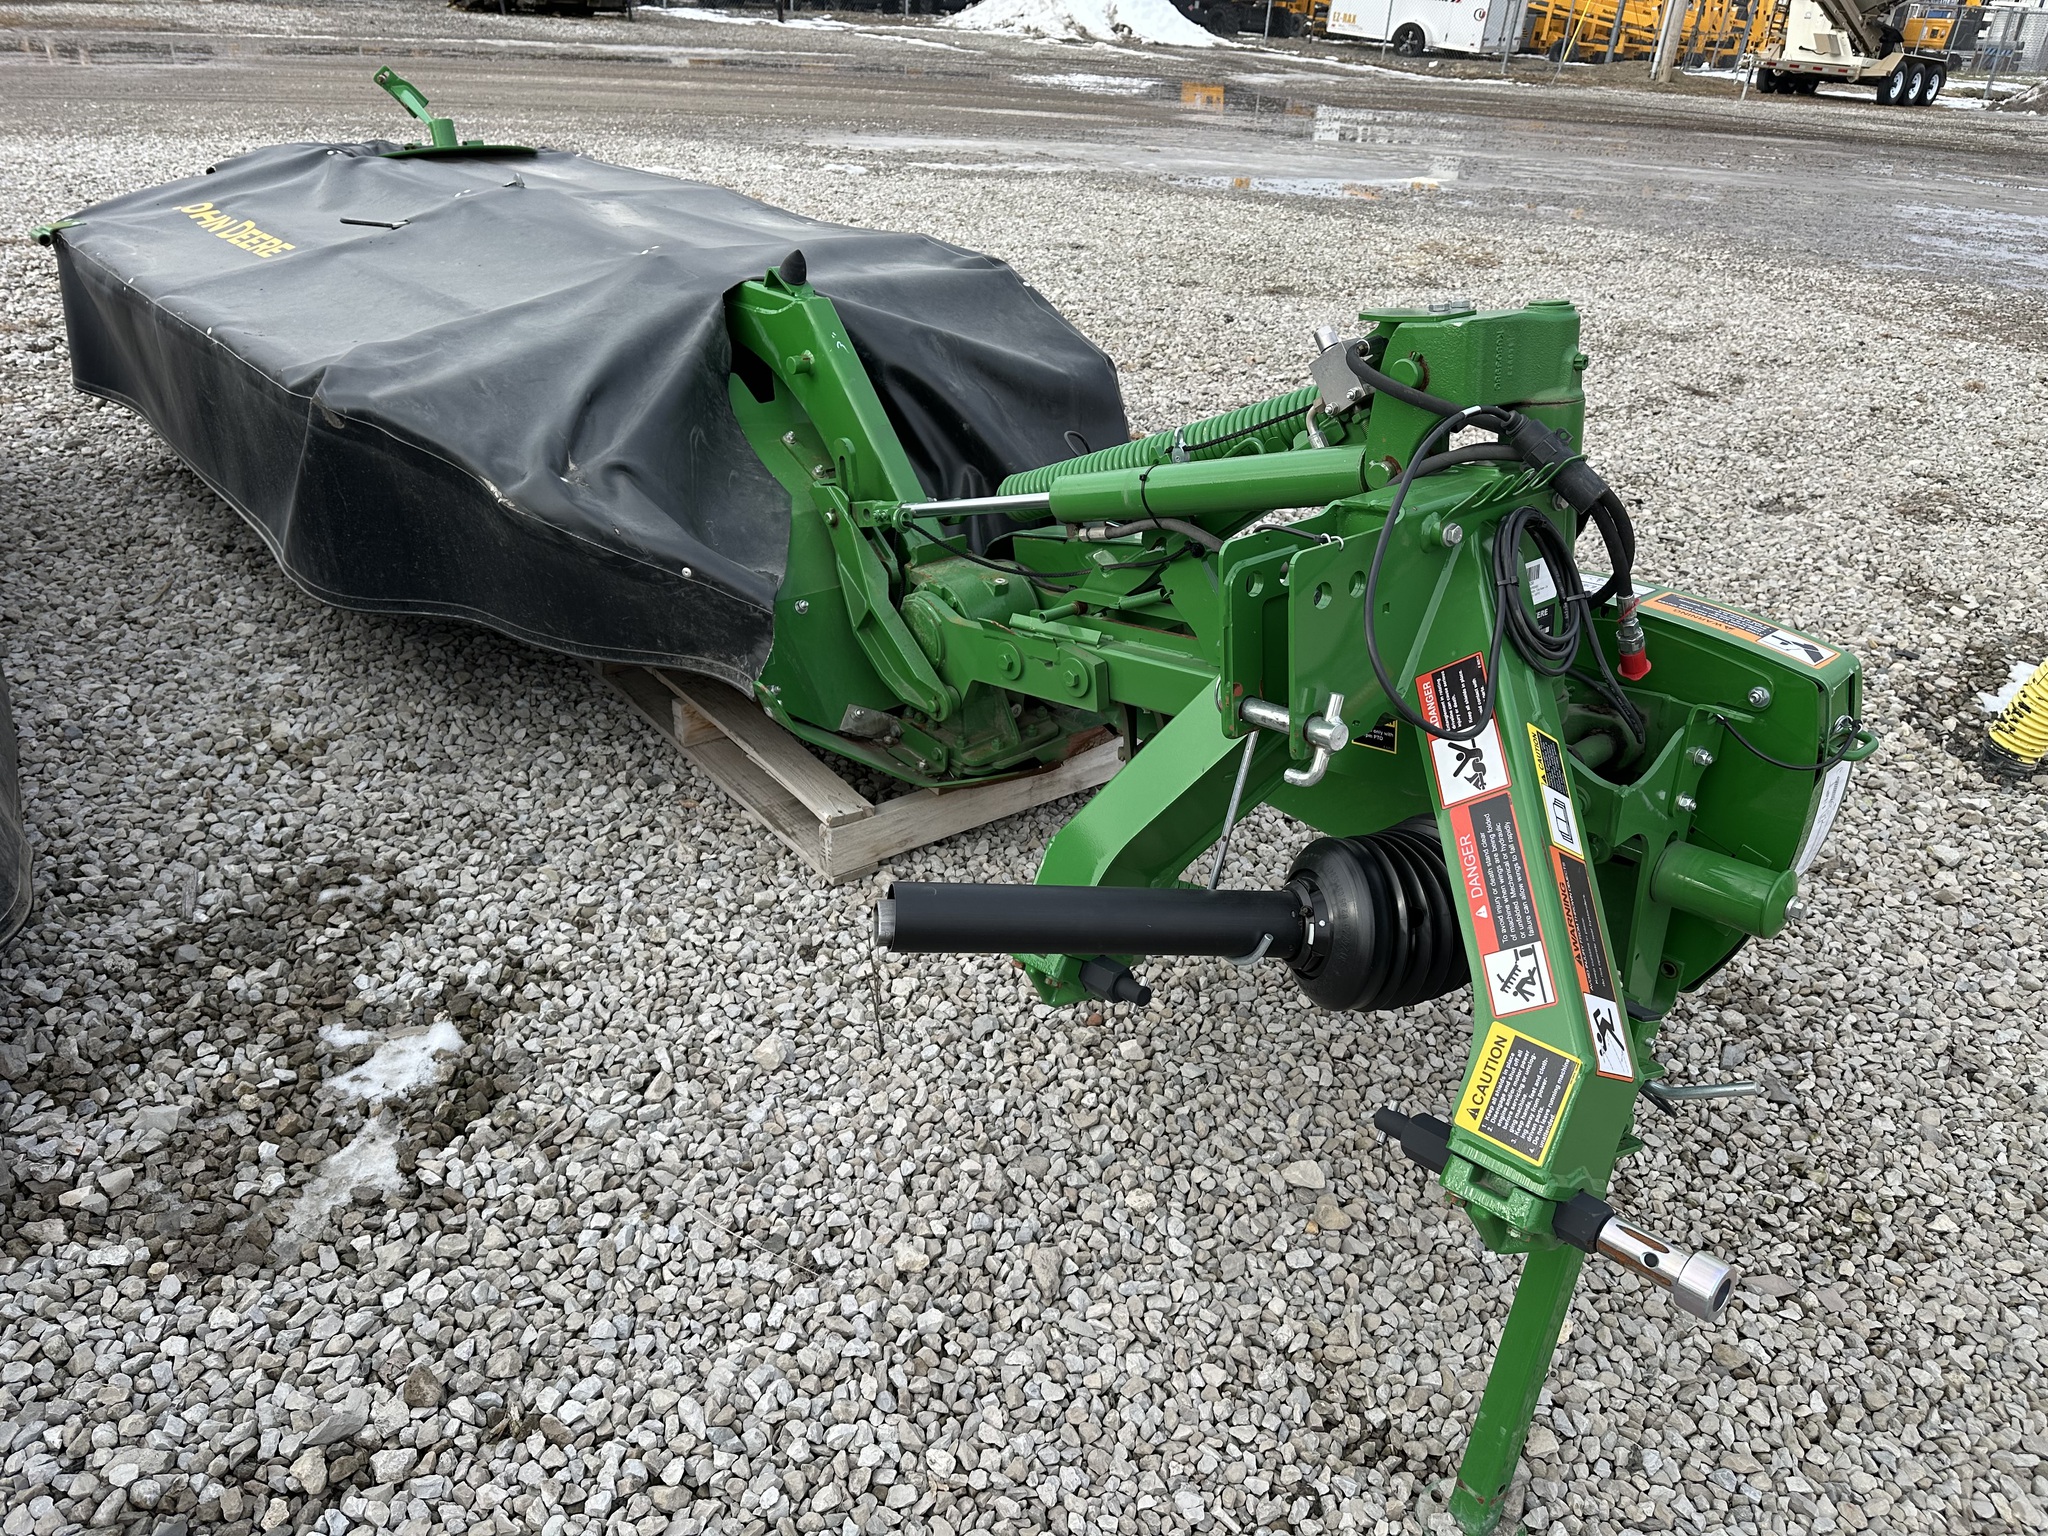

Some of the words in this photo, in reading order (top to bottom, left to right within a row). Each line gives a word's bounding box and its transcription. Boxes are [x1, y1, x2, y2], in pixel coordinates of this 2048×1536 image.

[172, 202, 238, 232] OHN
[215, 220, 296, 258] DEERE
[1422, 681, 1438, 724] DANGER
[1531, 731, 1544, 771] CAUTION
[1483, 813, 1493, 833] folded
[1479, 831, 1487, 848] clear
[1488, 833, 1498, 852] being
[1494, 822, 1507, 852] hydraulic
[1458, 833, 1483, 898] DANGER
[1482, 848, 1491, 866] stand
[1486, 867, 1496, 886] death
[1496, 864, 1505, 884] wings
[1503, 860, 1516, 898] Mechanical
[1513, 861, 1523, 882] wings
[1500, 884, 1508, 903] when
[1517, 882, 1526, 900] allow
[1493, 895, 1503, 914] injury
[1497, 915, 1506, 933] avoid
[1504, 904, 1515, 932] machine
[1524, 914, 1534, 936] failure
[1558, 880, 1580, 952] WARNING
[1501, 934, 1508, 943] To
[1520, 930, 1525, 938] or
[1470, 1034, 1507, 1106] CAUTION
[1484, 1104, 1494, 1121] Keep
[1494, 1075, 1506, 1096] shields
[1490, 1092, 1507, 1124] Disengage
[1502, 1080, 1510, 1092] and
[1507, 1066, 1516, 1080] shut
[1496, 1106, 1508, 1127] engine
[1504, 1086, 1515, 1106] and/or
[1512, 1068, 1522, 1086] motor
[1519, 1049, 1530, 1069] power
[1502, 1110, 1513, 1130] before
[1510, 1082, 1525, 1110] servicing
[1508, 1118, 1518, 1133] ging
[1514, 1091, 1528, 1119] machine.
[1514, 1119, 1525, 1136] Keep
[1528, 1086, 1537, 1099] feet
[1533, 1074, 1541, 1087] and
[1531, 1097, 1540, 1112] from
[1532, 1135, 1539, 1145] Do
[1540, 1108, 1550, 1124] leave
[1547, 1084, 1561, 1108] running
[1556, 1058, 1570, 1084] machine
[1524, 1112, 1535, 1129] away
[1520, 1128, 1529, 1139] ing
[1526, 1122, 1537, 1142] driven
